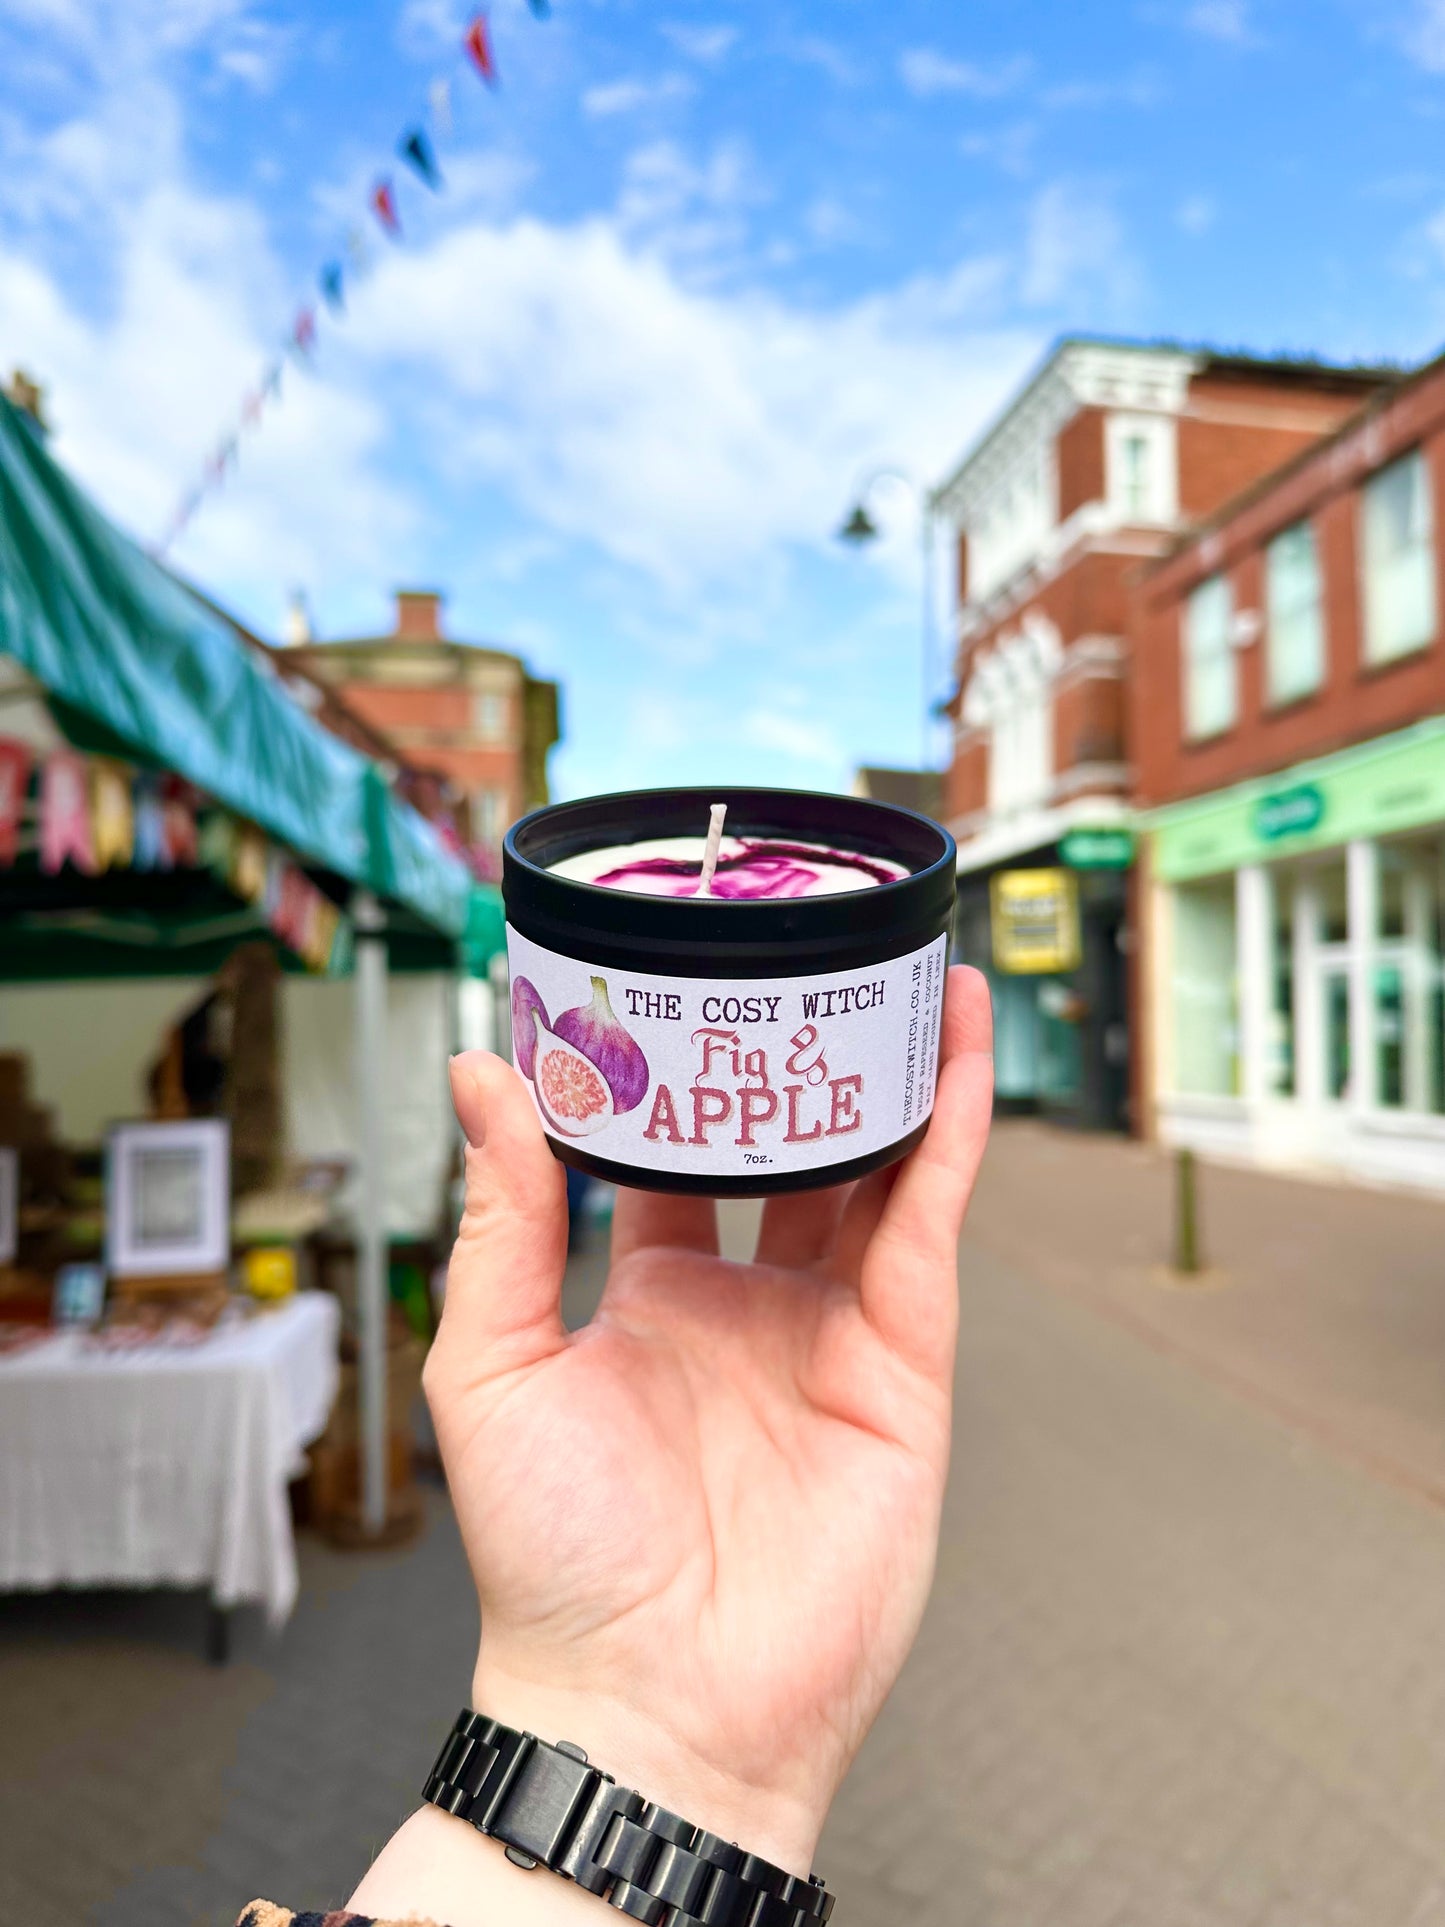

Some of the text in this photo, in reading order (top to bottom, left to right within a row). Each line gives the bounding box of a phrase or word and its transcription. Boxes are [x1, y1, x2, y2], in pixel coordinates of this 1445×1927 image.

[625, 981, 886, 1023] THE COSY WITCH
[925, 954, 934, 1003] COCONUT
[903, 960, 921, 1126] THECOSYWITCH.CO.UK
[920, 1022, 929, 1077] RAPESEED
[930, 1005, 938, 1046] POURED
[690, 1023, 829, 1089] Fig &
[643, 1074, 864, 1148] APPLE
[917, 1082, 925, 1117] VEGAN
[743, 1153, 774, 1165] 7oz.
